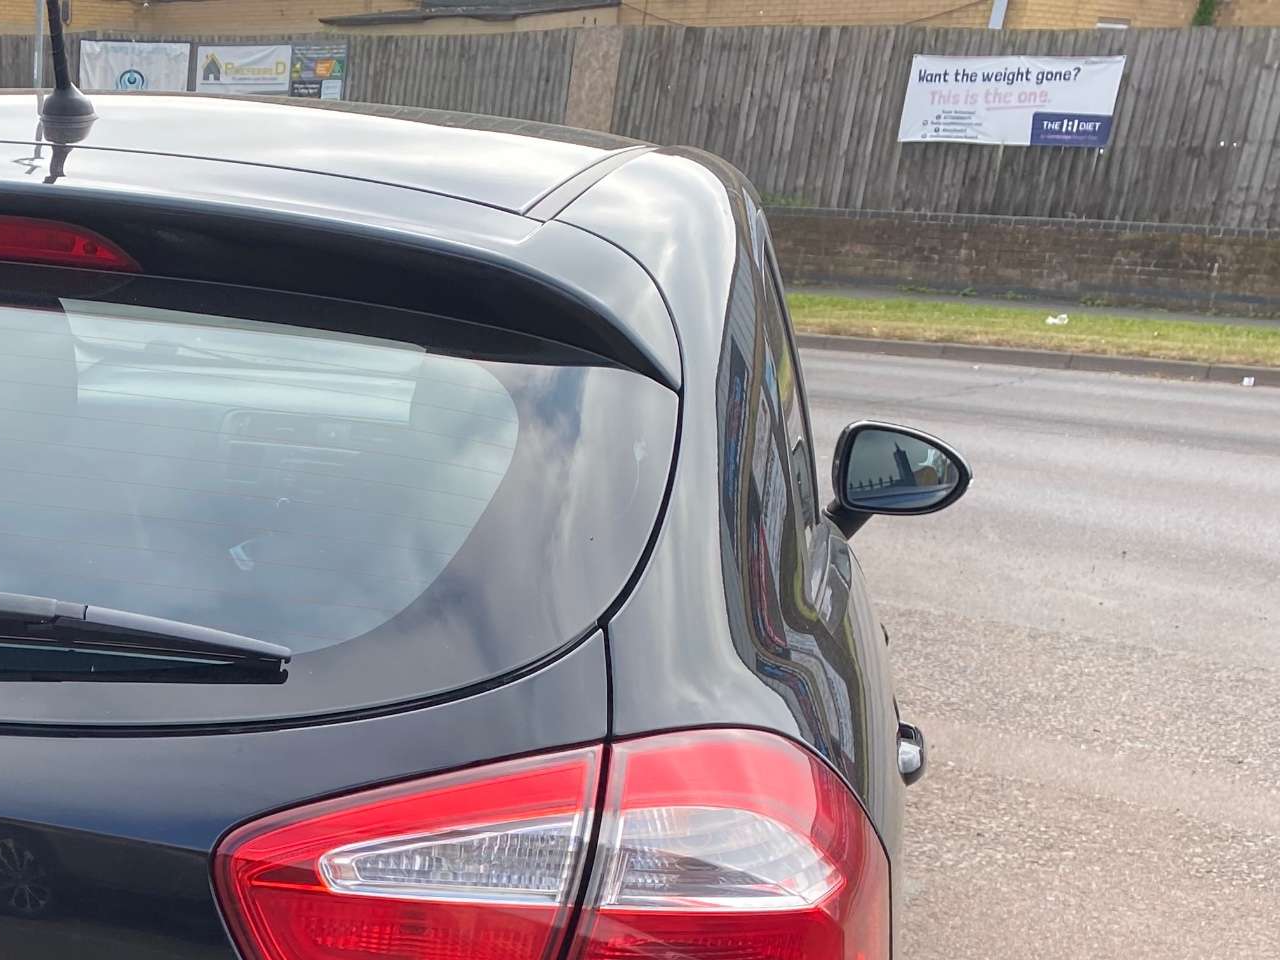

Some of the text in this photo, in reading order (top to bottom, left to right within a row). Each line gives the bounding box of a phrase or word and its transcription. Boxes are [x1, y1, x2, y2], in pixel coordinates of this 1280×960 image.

[918, 66, 1081, 85] Want the weight gone?
[929, 90, 960, 105] This
[965, 90, 977, 105] is
[984, 89, 1012, 104] the
[1043, 120, 1061, 130] THE
[1079, 121, 1102, 131] DIET
